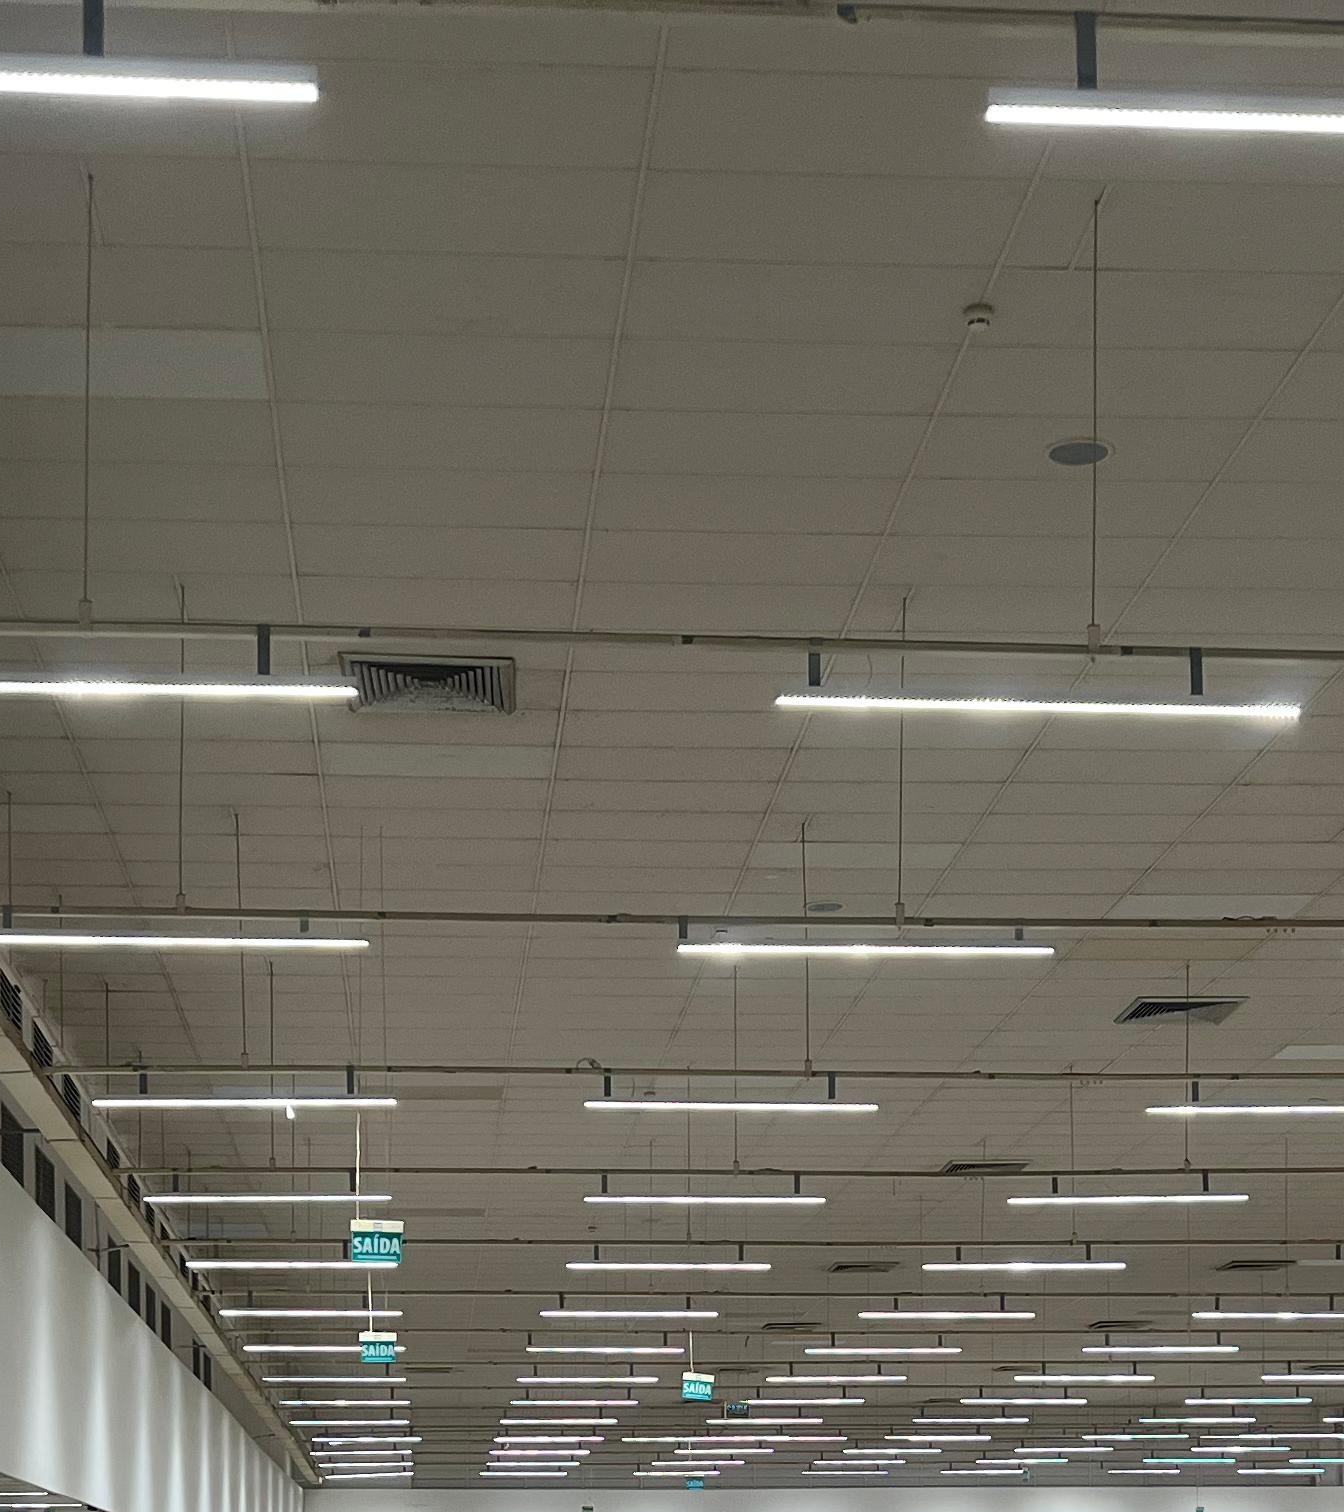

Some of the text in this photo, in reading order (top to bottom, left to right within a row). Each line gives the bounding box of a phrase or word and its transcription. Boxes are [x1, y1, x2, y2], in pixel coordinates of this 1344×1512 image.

[353, 1234, 401, 1255] SAÍDA
[362, 1343, 395, 1357] SAÍDA
[683, 1382, 712, 1396] SAÍDA
